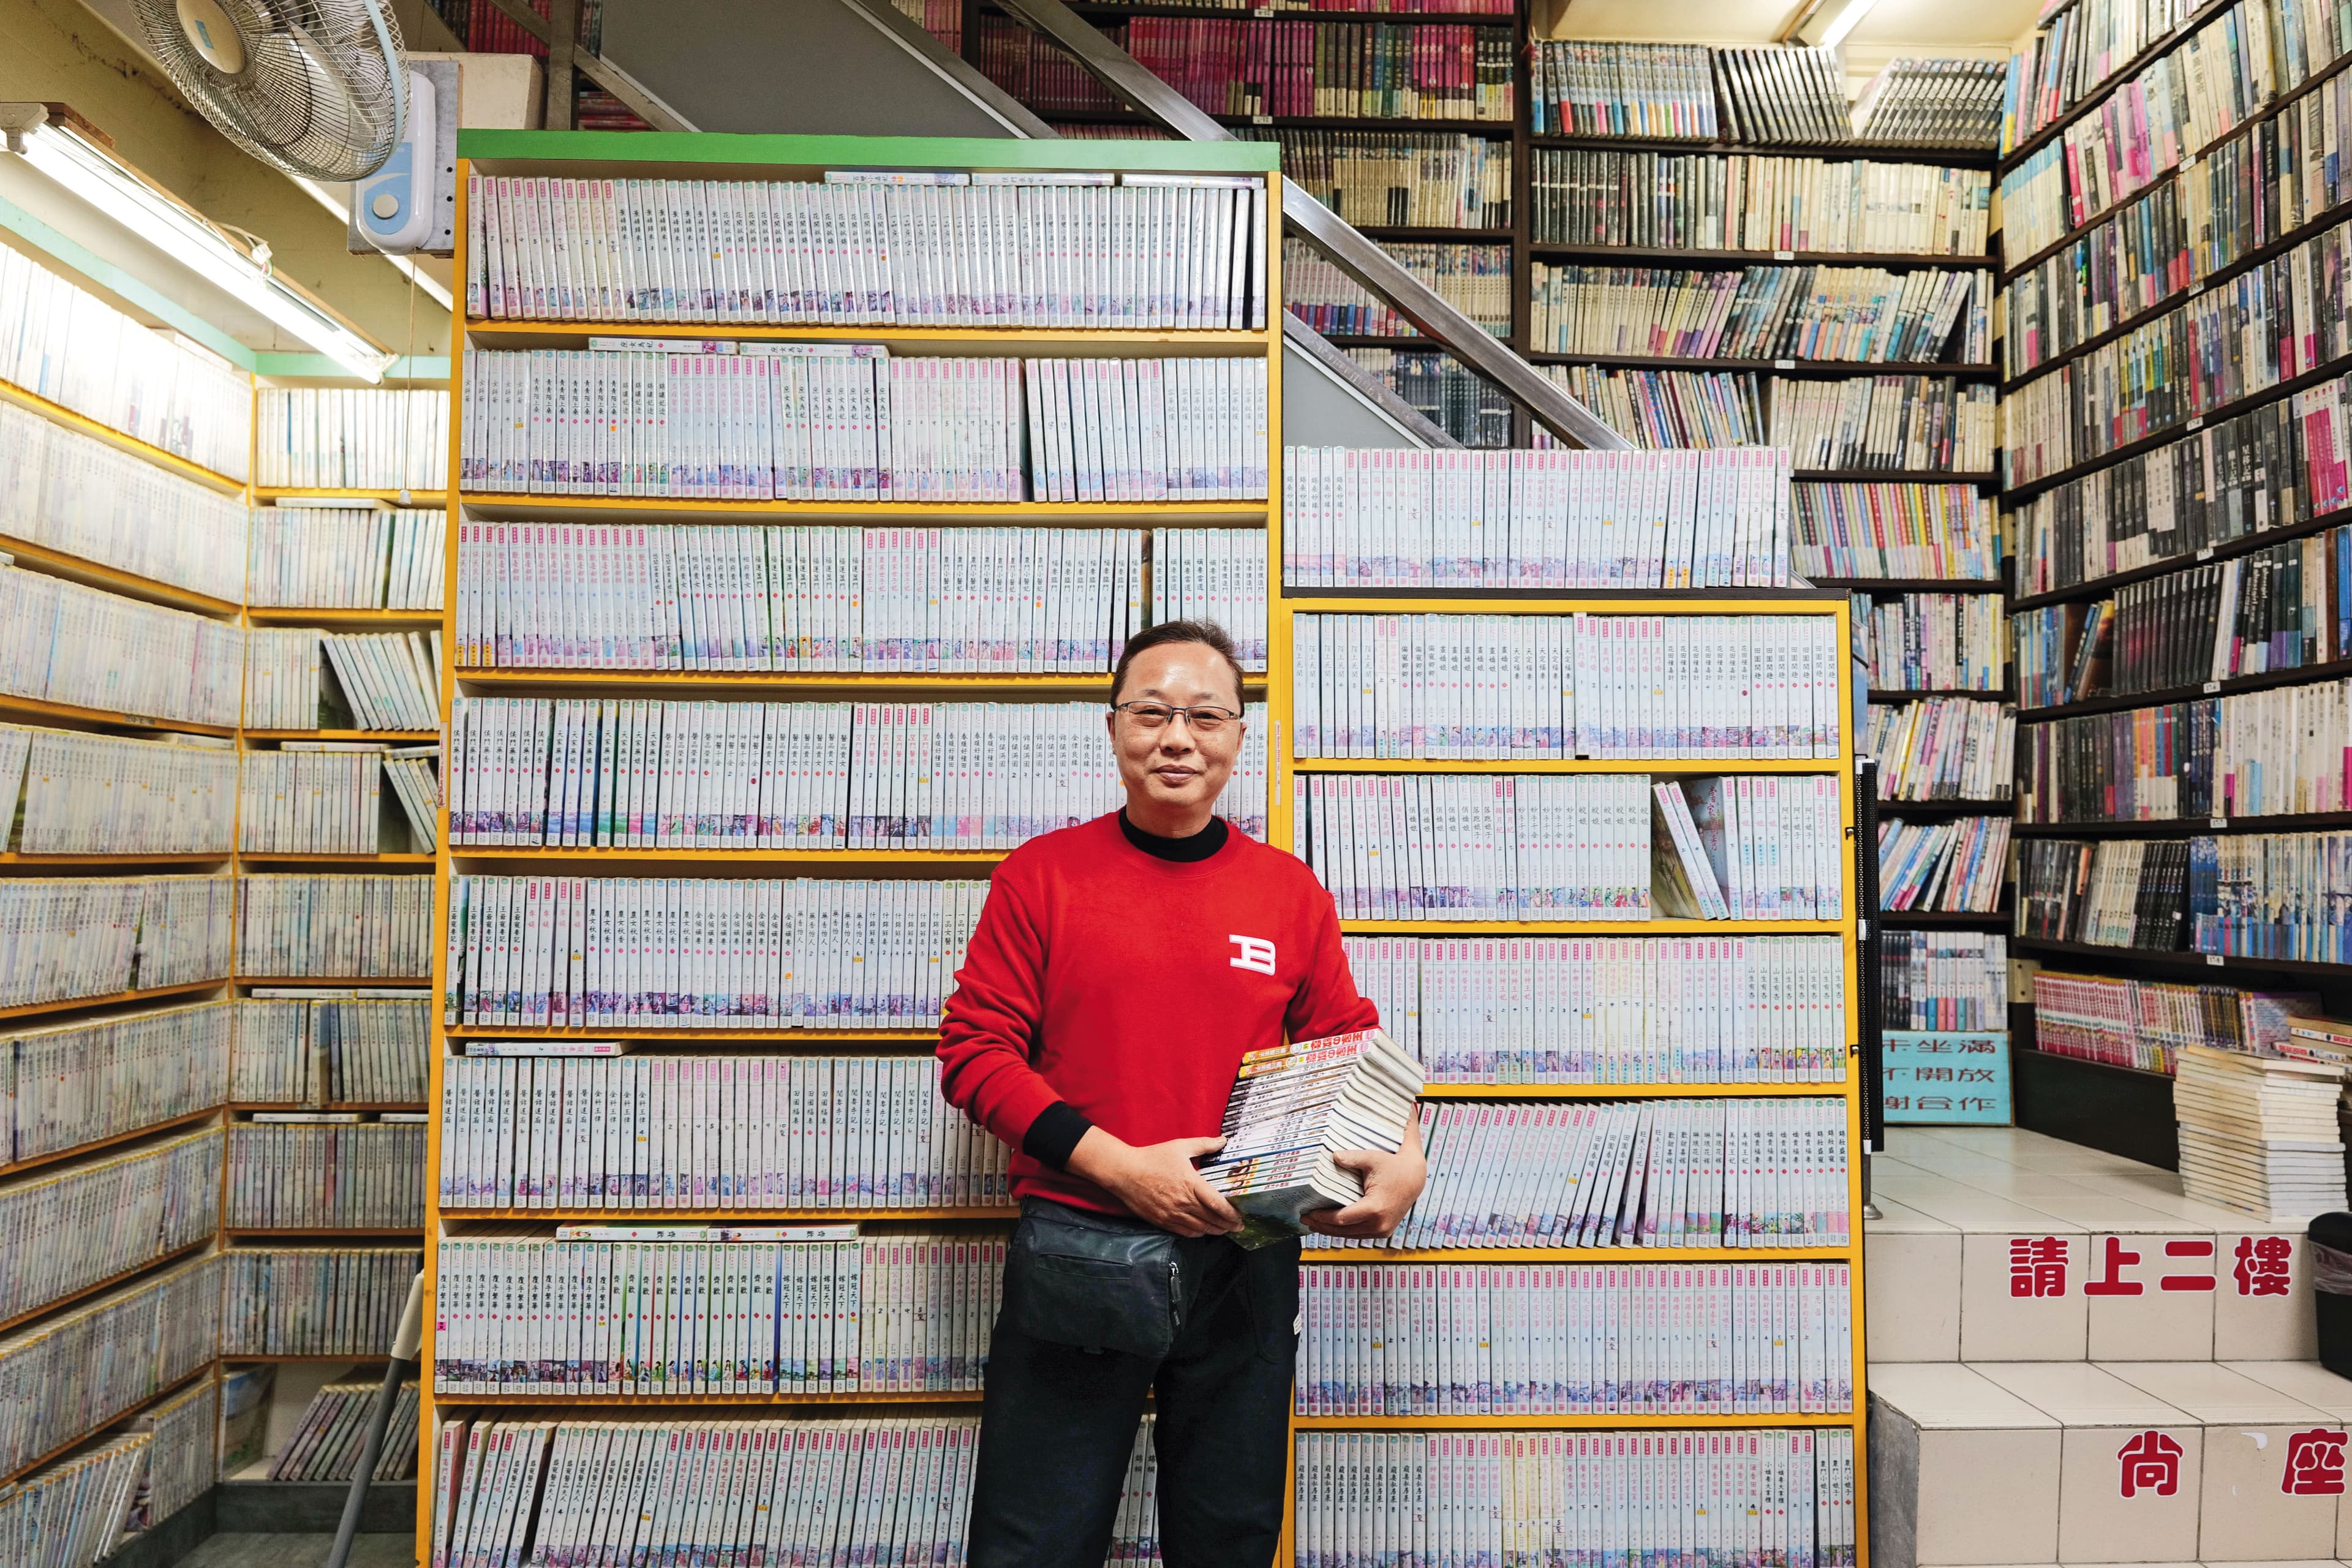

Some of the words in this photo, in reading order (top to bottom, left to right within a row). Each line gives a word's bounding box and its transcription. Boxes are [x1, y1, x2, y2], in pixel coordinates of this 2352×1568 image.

[1517, 807, 1526, 839] 妙手千金
[1542, 806, 1551, 839] 妙手千金
[1883, 1067, 1995, 1082] 不開放
[1637, 1131, 1646, 1166] 旺夫小王妃
[1652, 1129, 1661, 1165] 旺夫小王妃
[2010, 1236, 2292, 1298] 請上二樓
[2117, 1430, 2184, 1498] 尚
[2282, 1428, 2348, 1495] 座
